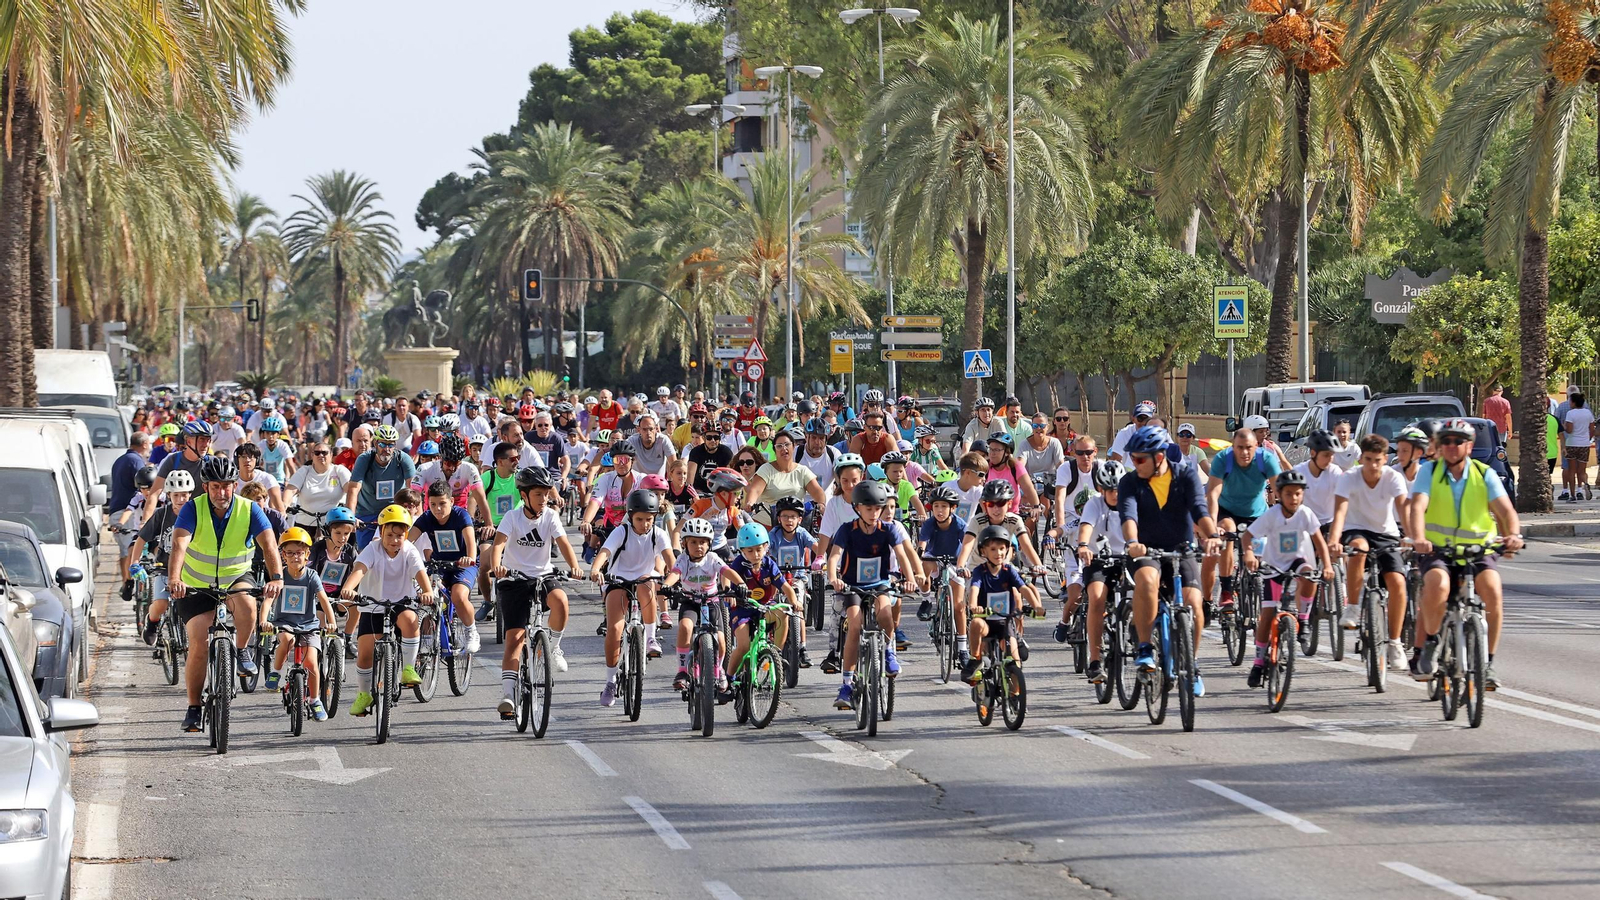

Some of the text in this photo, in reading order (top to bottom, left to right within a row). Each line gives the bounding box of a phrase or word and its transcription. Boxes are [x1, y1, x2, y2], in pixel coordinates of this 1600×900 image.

[1402, 285, 1428, 296] Par
[830, 330, 874, 340] Restaurante
[516, 539, 545, 548] adidas
